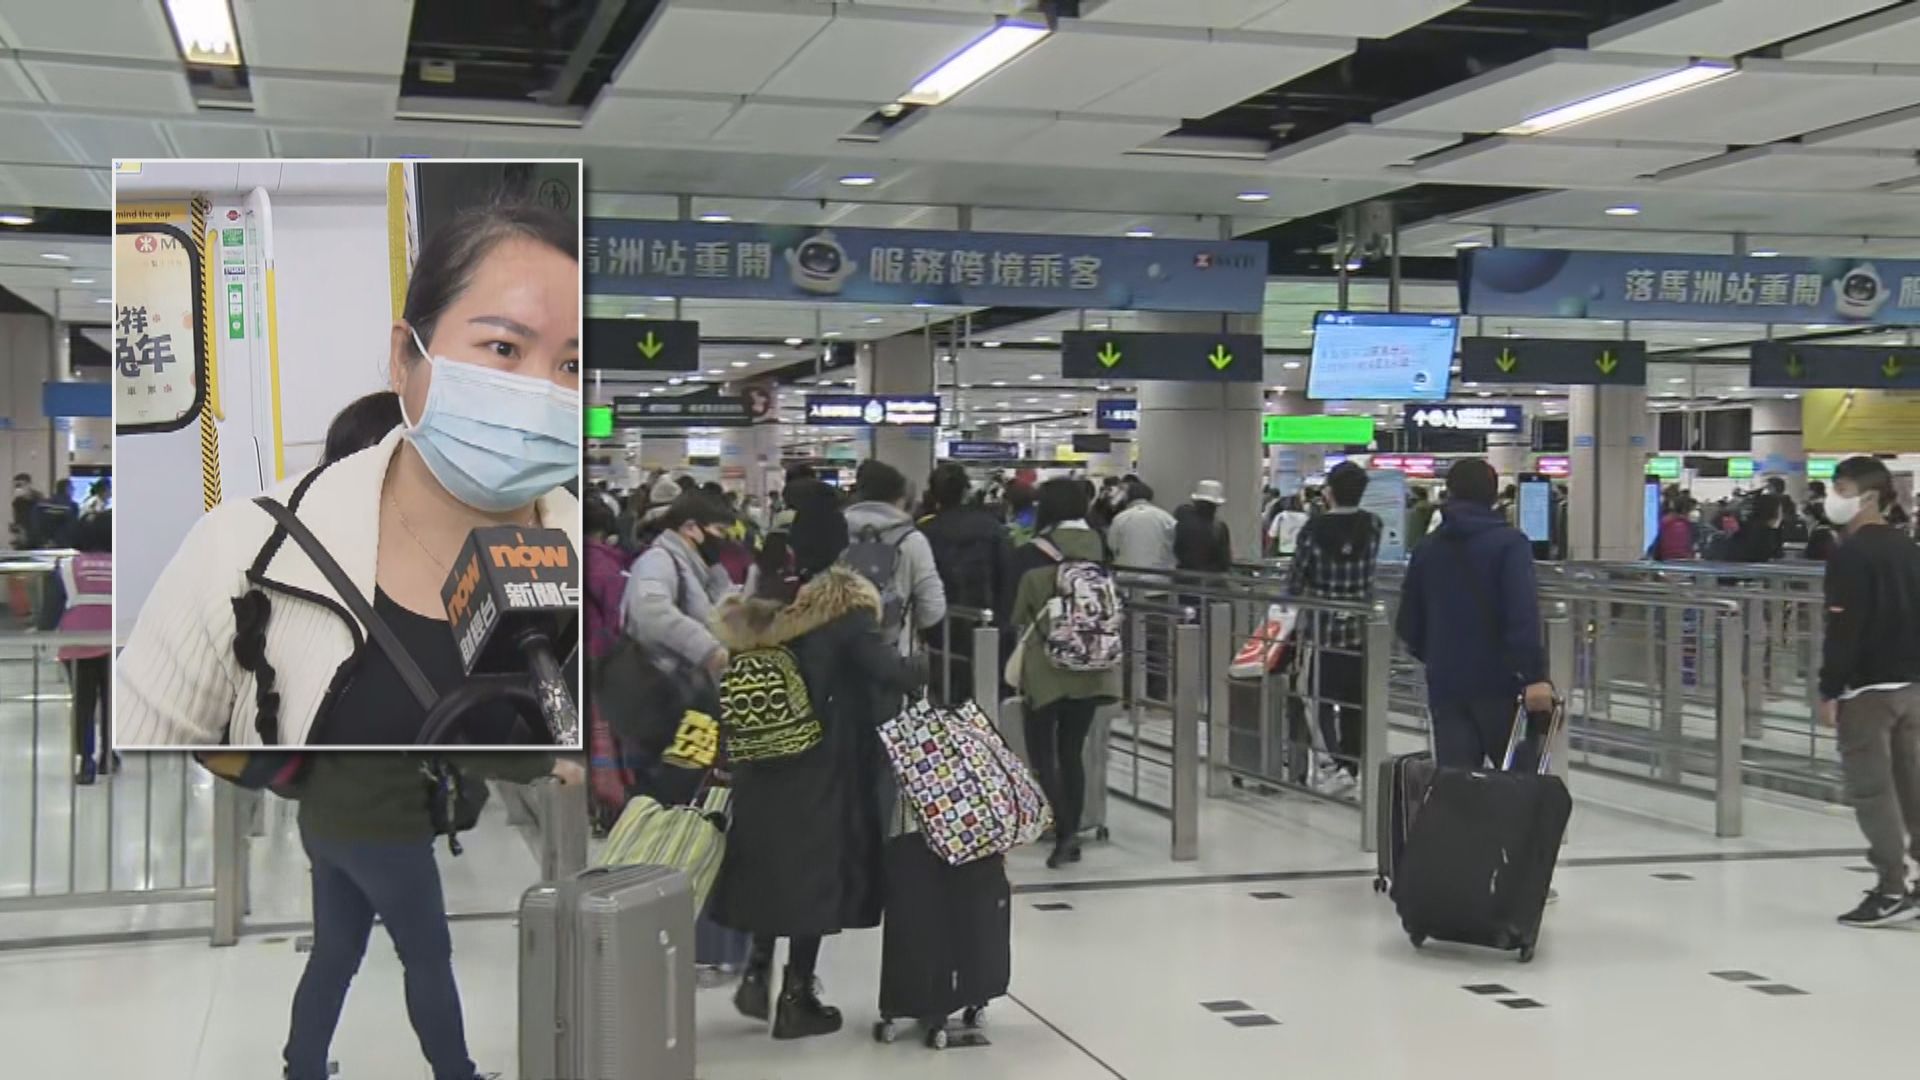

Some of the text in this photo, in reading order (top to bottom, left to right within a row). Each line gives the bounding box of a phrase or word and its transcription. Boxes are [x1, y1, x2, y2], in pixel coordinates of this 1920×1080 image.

[116, 210, 171, 221] mind the gap
[870, 246, 1102, 290] 服務跨境乘客
[1624, 268, 1823, 306] 落馬洲站重開
[116, 303, 148, 335] 祥
[488, 545, 569, 568] now
[447, 552, 481, 626] now
[503, 581, 579, 608] 新聞台
